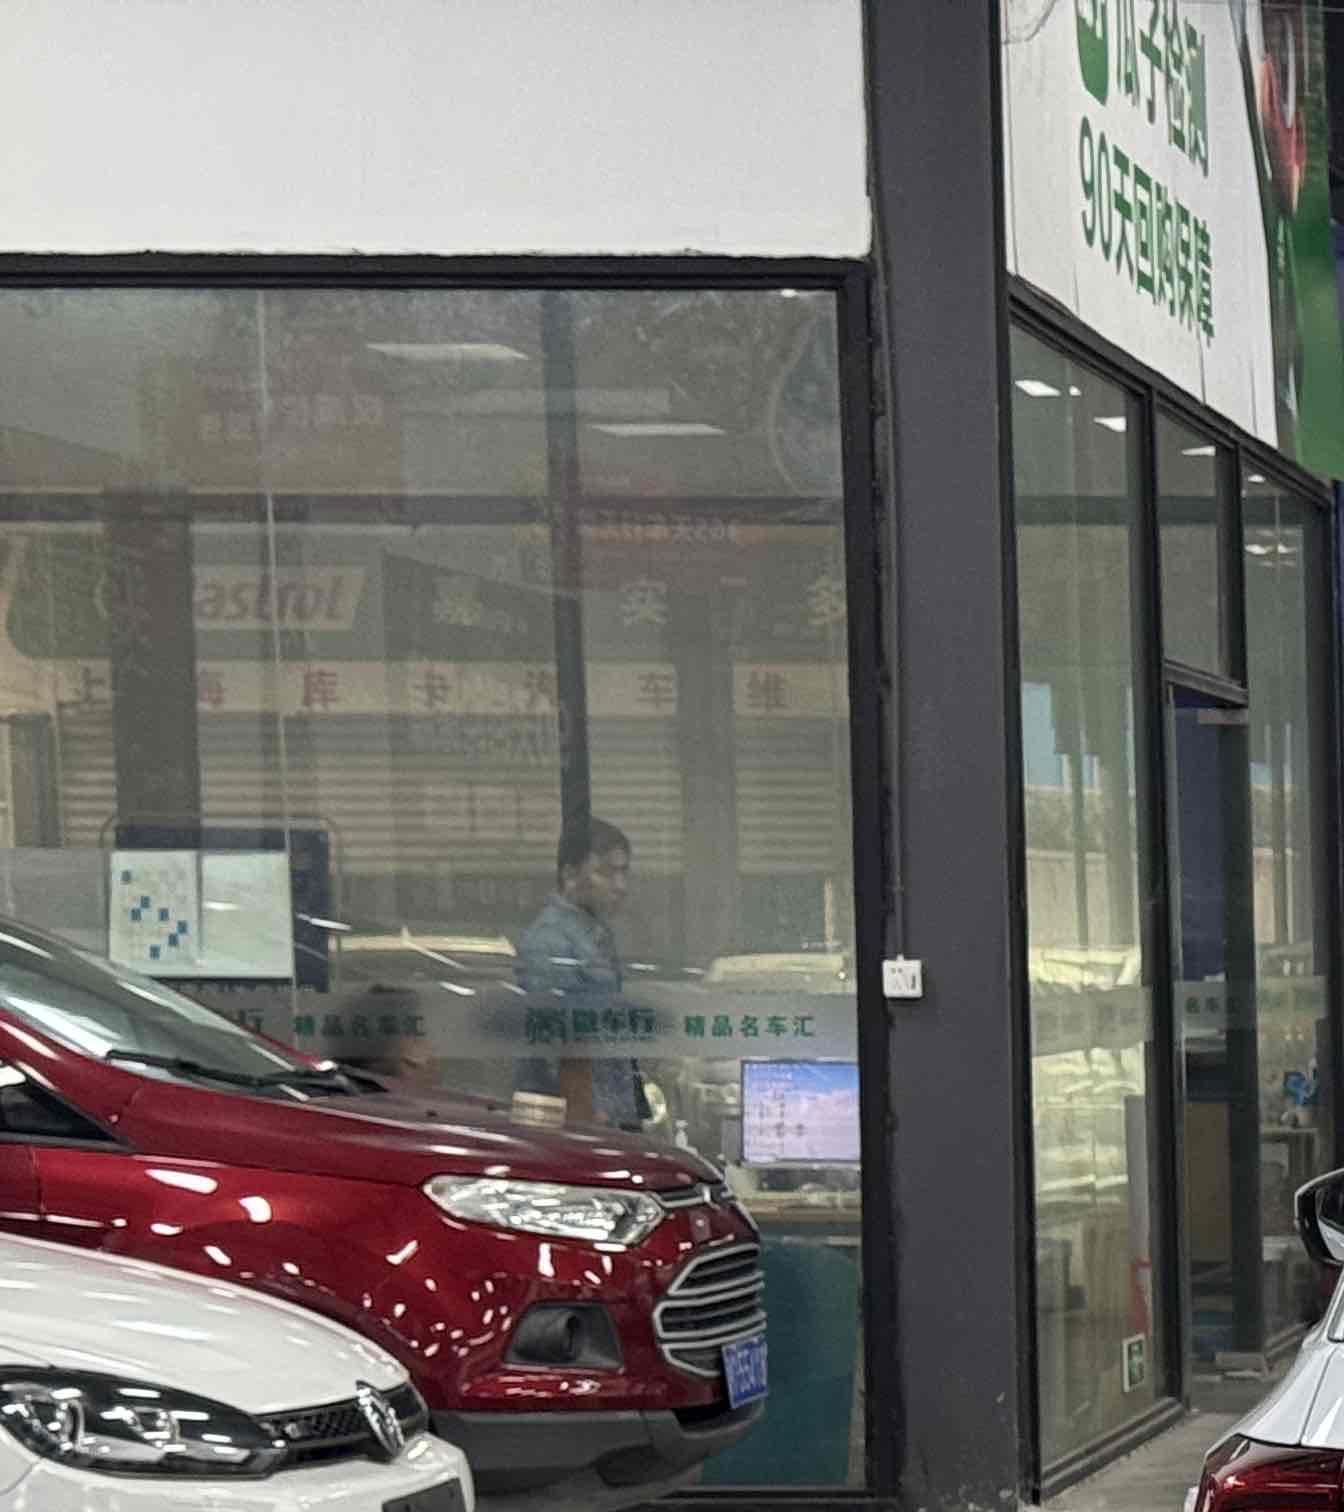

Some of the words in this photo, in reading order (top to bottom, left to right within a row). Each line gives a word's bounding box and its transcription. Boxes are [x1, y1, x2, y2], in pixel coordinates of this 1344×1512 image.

[684, 1015, 814, 1038] 精品名车汇
